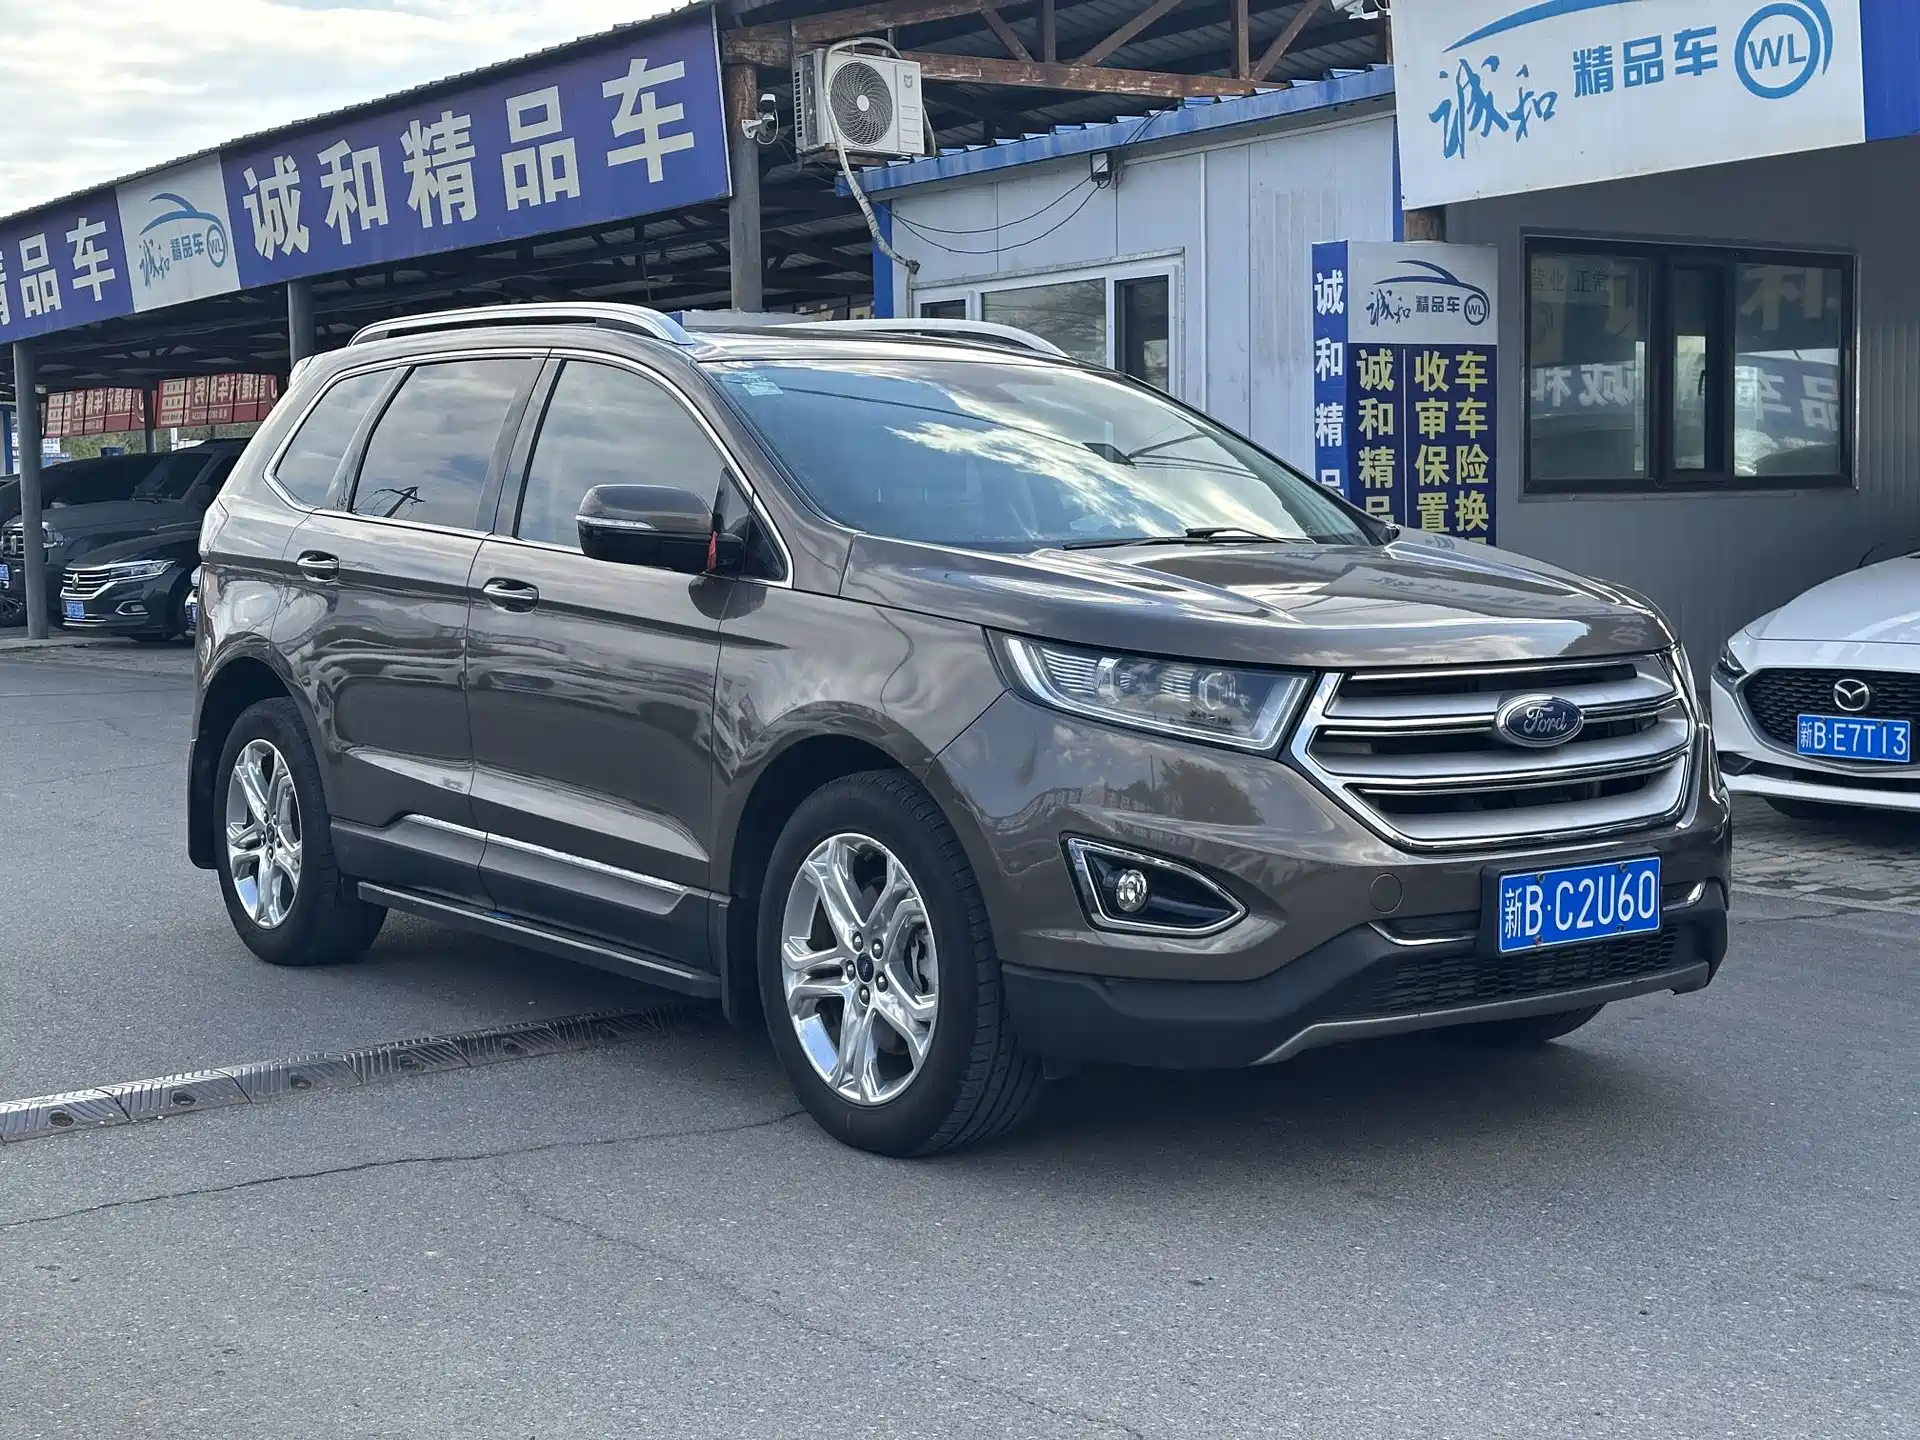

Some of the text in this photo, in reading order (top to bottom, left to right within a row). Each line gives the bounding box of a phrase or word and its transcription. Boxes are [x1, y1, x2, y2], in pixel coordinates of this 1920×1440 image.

[1748, 34, 1807, 71] WL
[1429, 25, 1718, 159] 诚和 精品车
[243, 58, 695, 260] 诚和精品车
[170, 233, 205, 262] 精品车
[209, 239, 224, 254] WL
[0, 218, 116, 325] 品车
[1416, 295, 1460, 313] 精品车
[1467, 304, 1484, 316] WL
[1523, 705, 1568, 734] Ford
